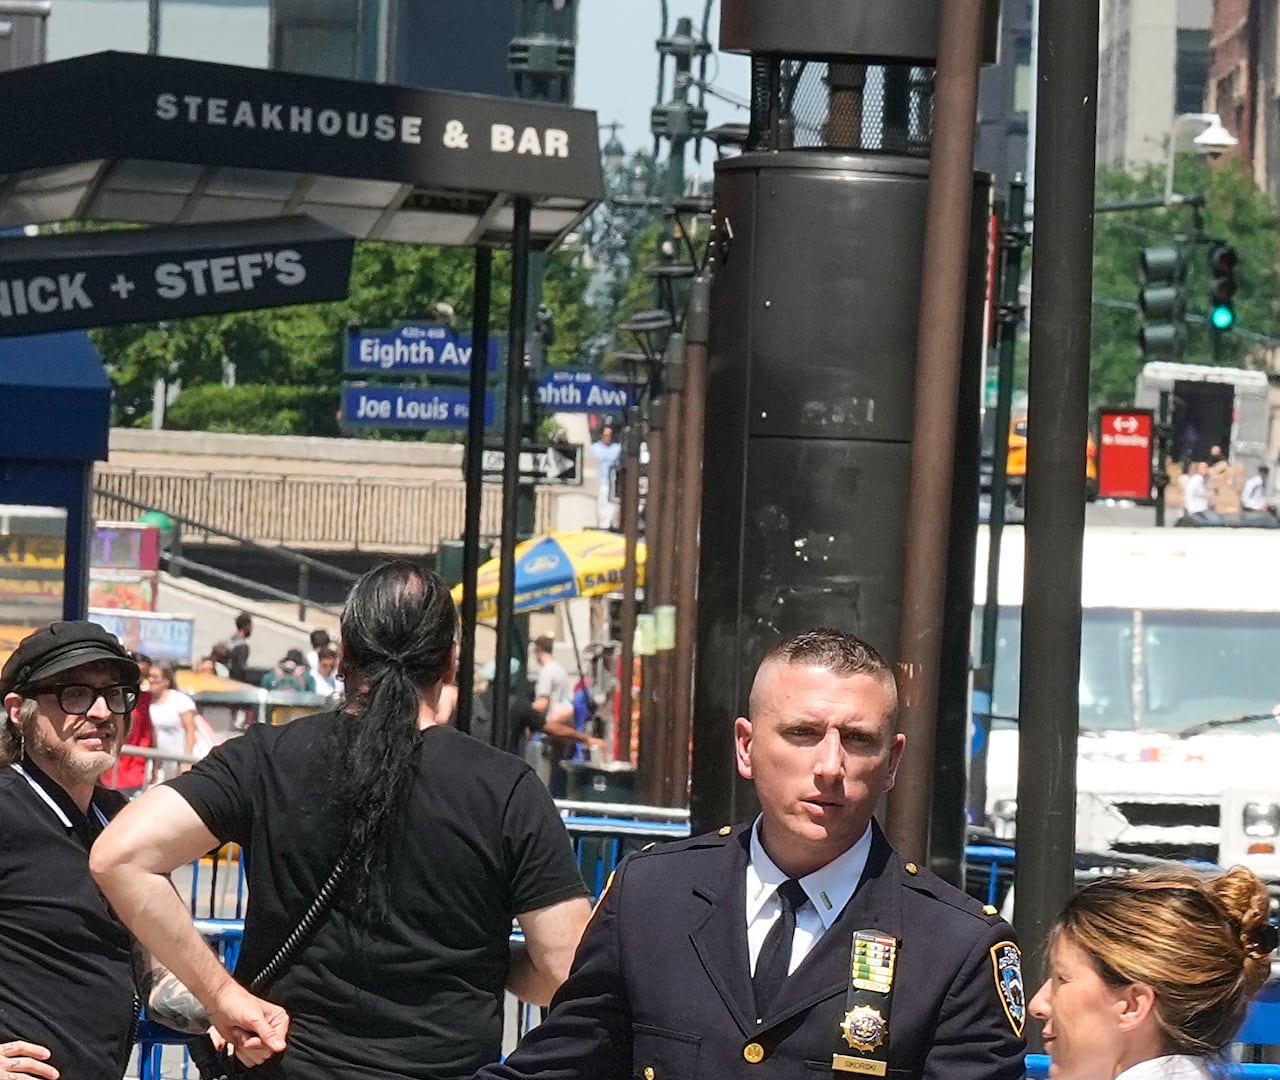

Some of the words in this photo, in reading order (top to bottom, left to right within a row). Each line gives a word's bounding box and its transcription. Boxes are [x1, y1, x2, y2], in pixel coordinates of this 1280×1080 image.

[155, 93, 421, 145] STEAKHOUSE
[443, 119, 469, 149] &
[491, 123, 569, 158] BAR
[359, 337, 435, 368] Eighth
[440, 340, 472, 365] Av
[357, 395, 391, 419] Joe
[396, 395, 449, 420] Louis
[1081, 746, 1207, 764] edEx
